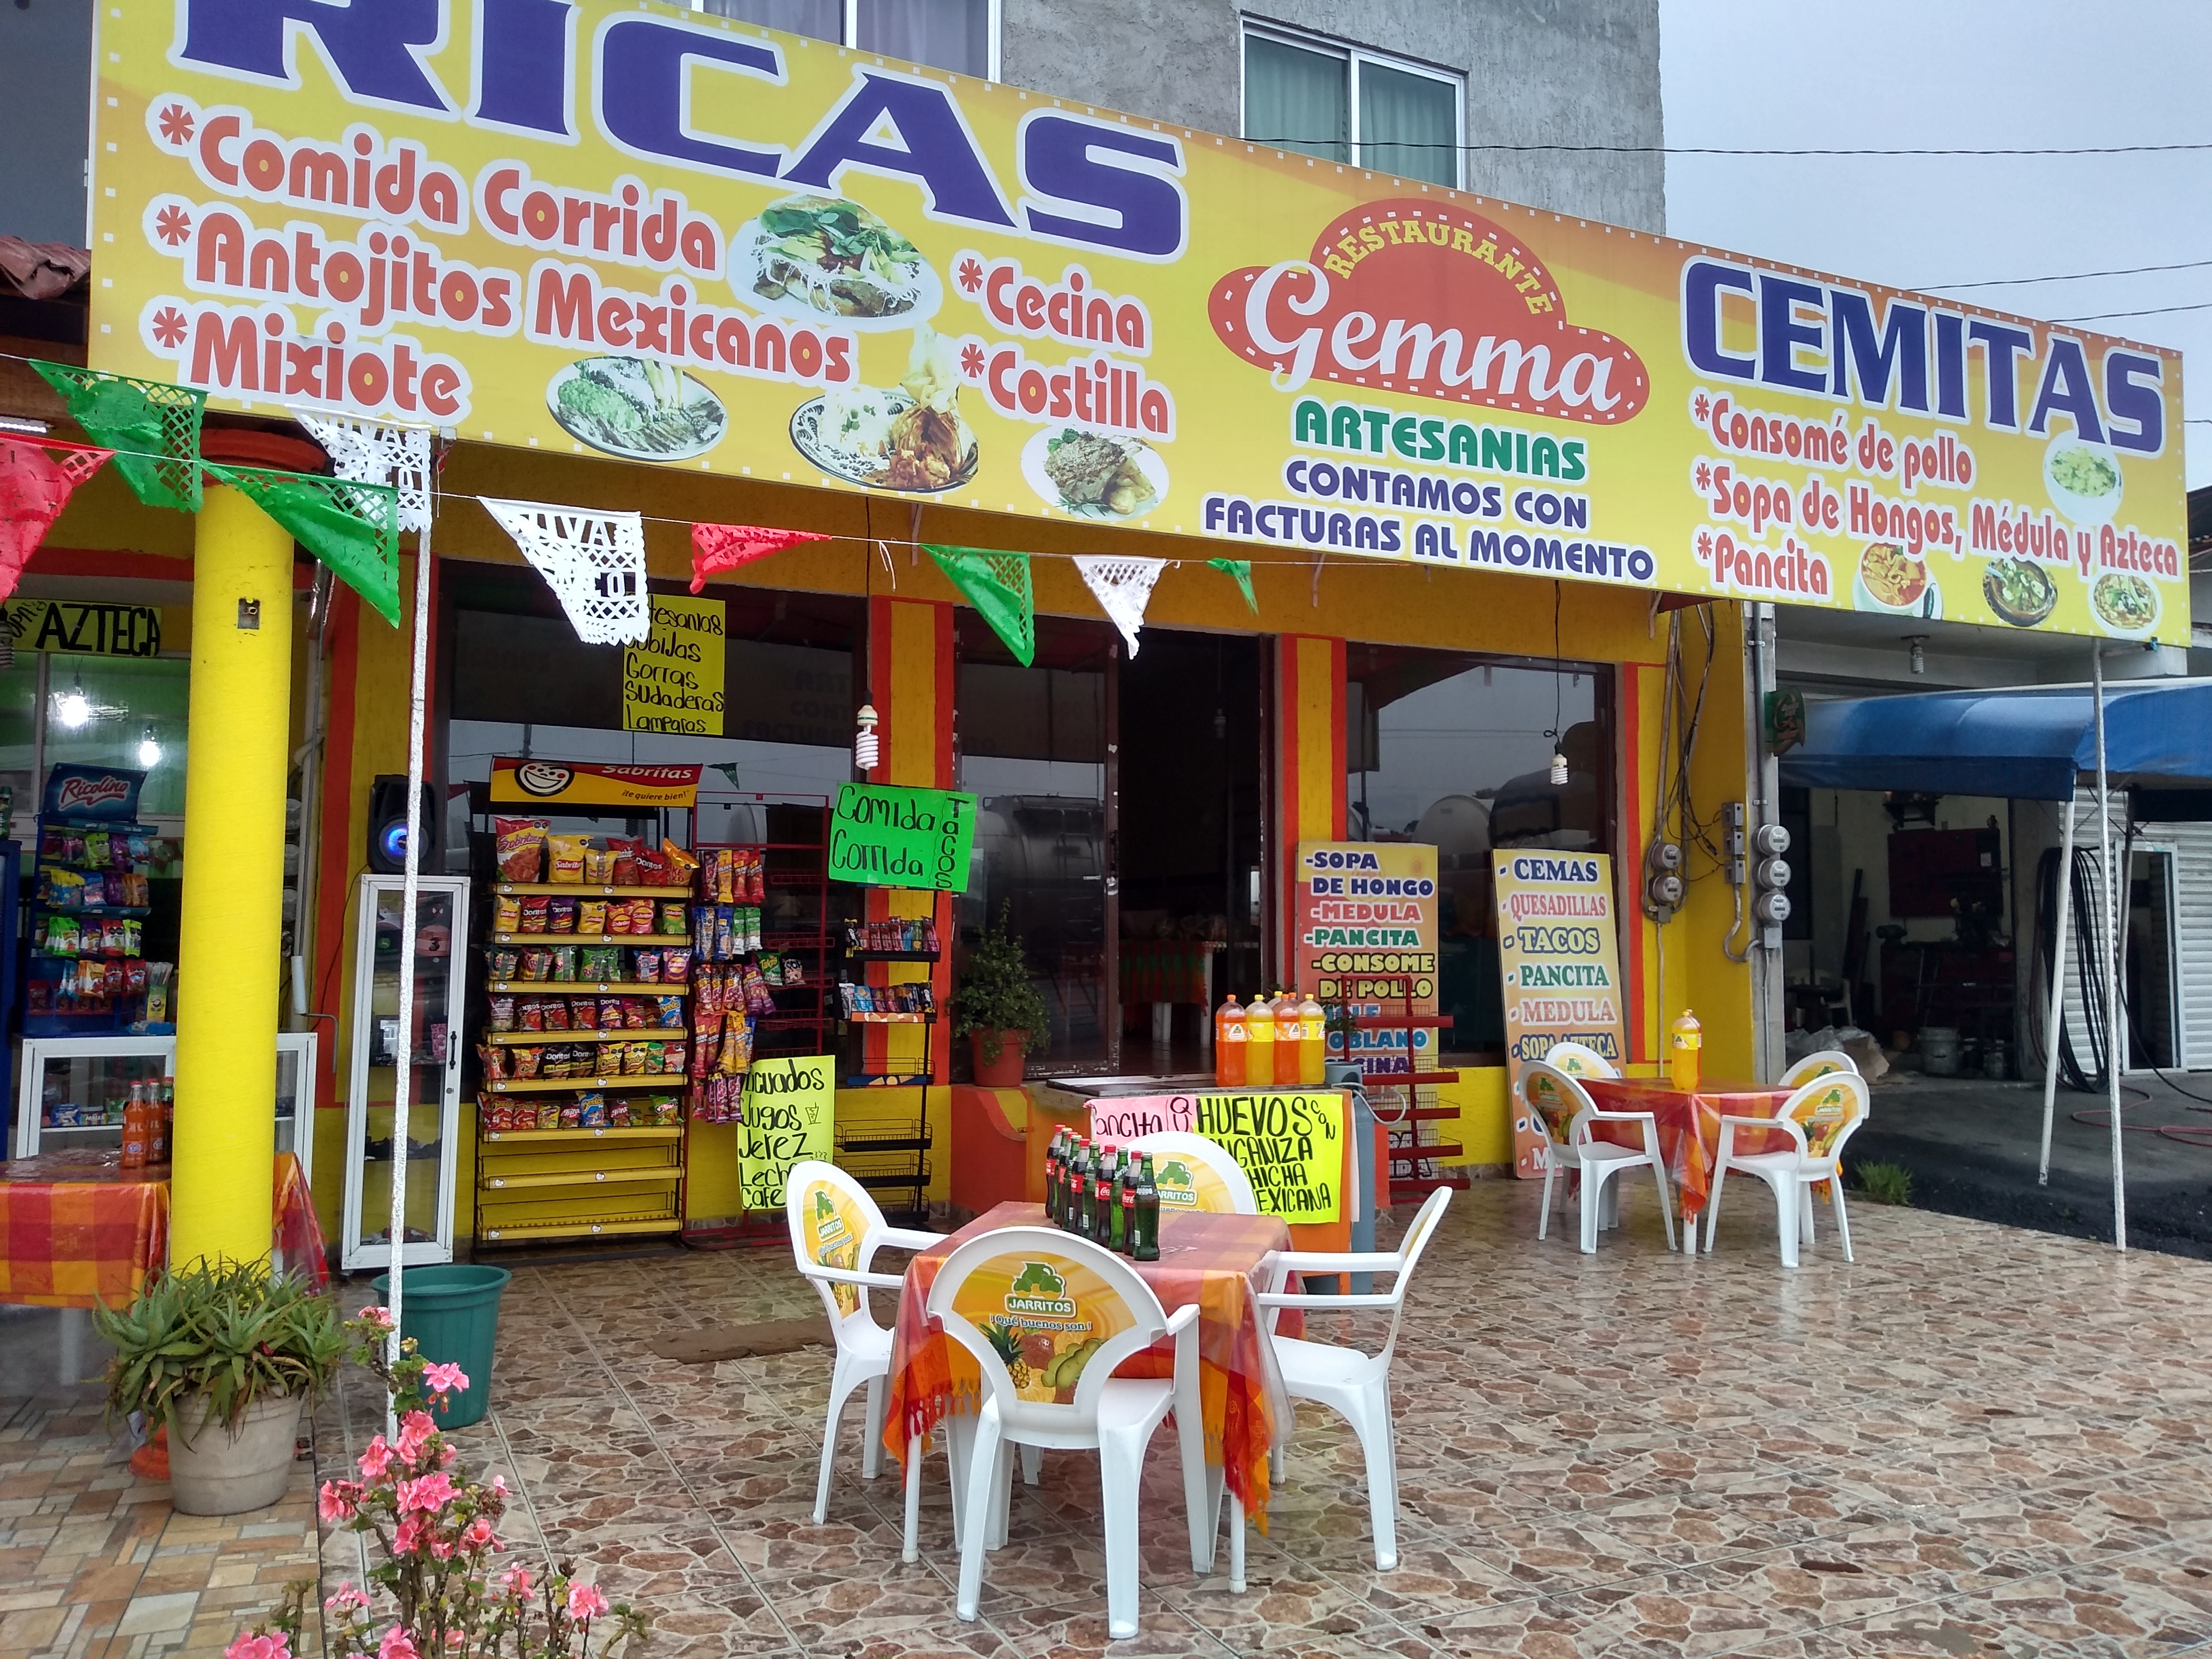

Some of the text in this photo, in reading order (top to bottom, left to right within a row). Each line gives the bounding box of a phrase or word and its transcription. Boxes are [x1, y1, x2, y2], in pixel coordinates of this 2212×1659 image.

[180, 0, 1181, 255] RICAS
[484, 169, 716, 271] Corrida
[1323, 219, 1553, 315] RESTAURANTE
[535, 269, 850, 382] Mexicanos
[1246, 260, 1621, 412] Gemma
[1687, 262, 2164, 453] CEMITAS
[1295, 401, 1586, 481] ARTESANIAS
[1859, 424, 1893, 472] de
[1905, 435, 1972, 490] pollo
[1287, 460, 1586, 529] CONTAMOS CON
[1205, 498, 1654, 581] FACTURAS AL MOMENTO
[1803, 481, 1839, 530] de
[1973, 504, 2068, 560] Médula
[2077, 532, 2089, 576] y
[2102, 529, 2178, 576] Azteca
[35, 602, 160, 656] AZTECA
[649, 594, 724, 636] tesanias
[626, 652, 699, 690] Gorras
[602, 765, 692, 779] Sabritas
[60, 775, 130, 803] Ricolino
[635, 791, 663, 800] quiere
[635, 857, 663, 870] Doritos
[1514, 859, 1598, 882] CEMAS
[1313, 877, 1434, 895] DE HONGO
[1510, 893, 1606, 922] QUESADILLAS
[1518, 927, 1600, 953] TACOS
[760, 957, 777, 971] Takis
[1520, 965, 1610, 986] PANCITA
[1522, 1000, 1615, 1022] MEDULA
[1329, 1030, 1427, 1049] OBLANO
[1196, 1096, 1313, 1137] HUEVOS
[1210, 1136, 1313, 1168] NGANIZA
[739, 1162, 798, 1187] Lech
[1157, 1190, 1194, 1201] ARRITOS
[1255, 1182, 1331, 1213] EXICANA
[819, 1219, 842, 1237] JARRITOS
[1009, 1297, 1071, 1313] JARRITOS
[1020, 1318, 1061, 1330] buenos
